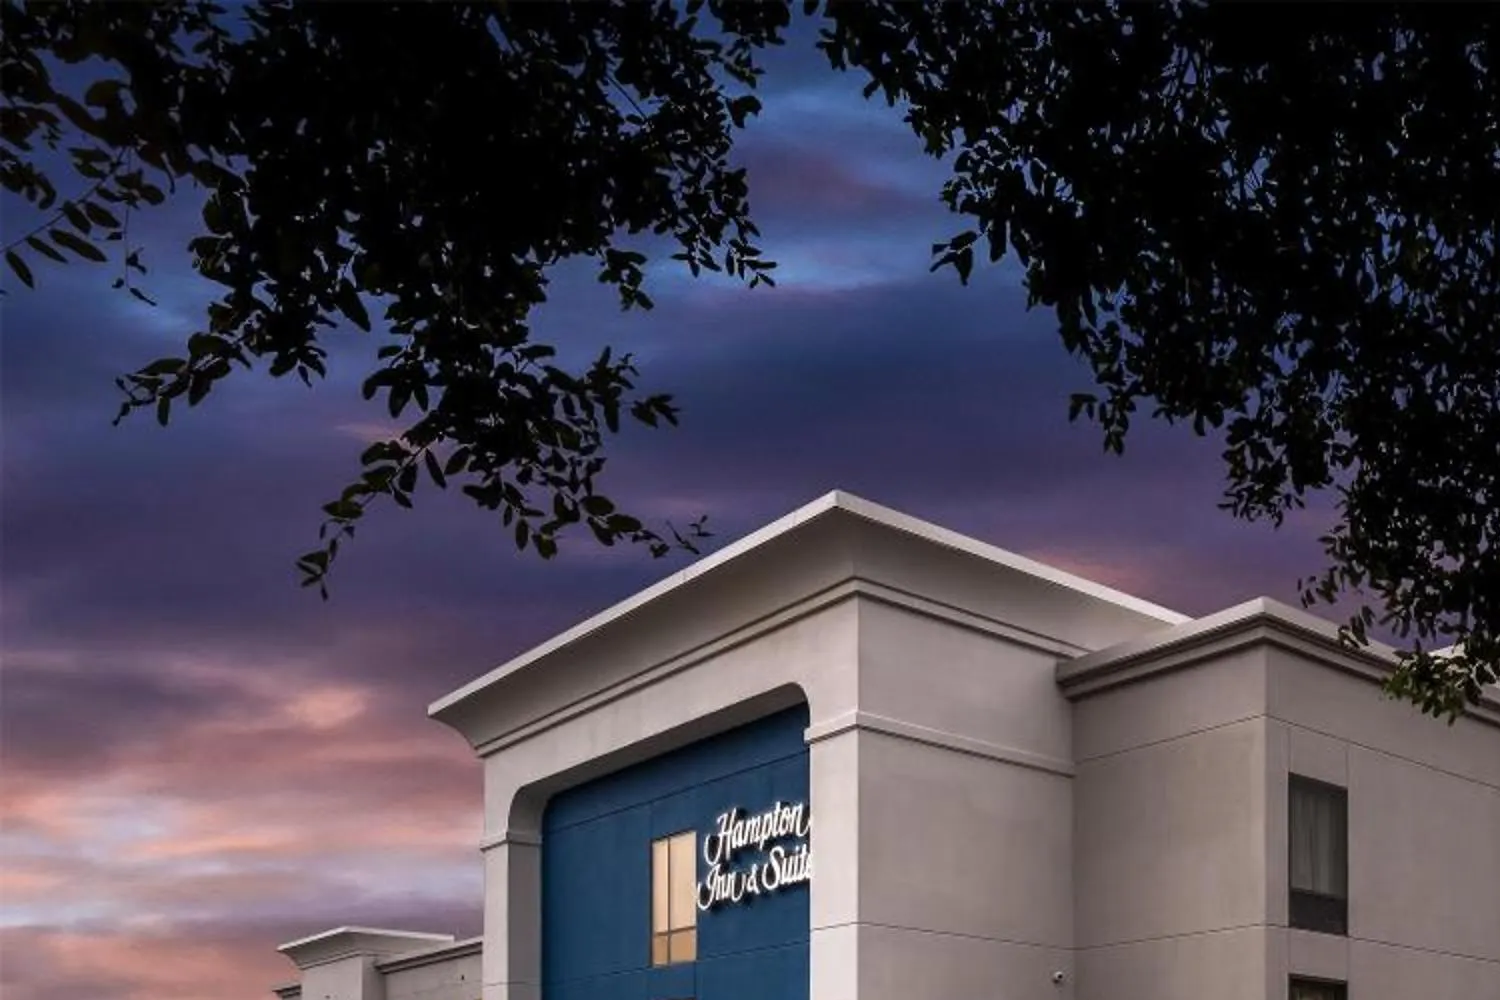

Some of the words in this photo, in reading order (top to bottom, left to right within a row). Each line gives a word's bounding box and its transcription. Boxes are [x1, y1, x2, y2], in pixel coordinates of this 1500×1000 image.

[704, 801, 812, 865] Hampton
[697, 864, 745, 910] Inn
[747, 864, 760, 894] &
[762, 844, 813, 890] Suite
